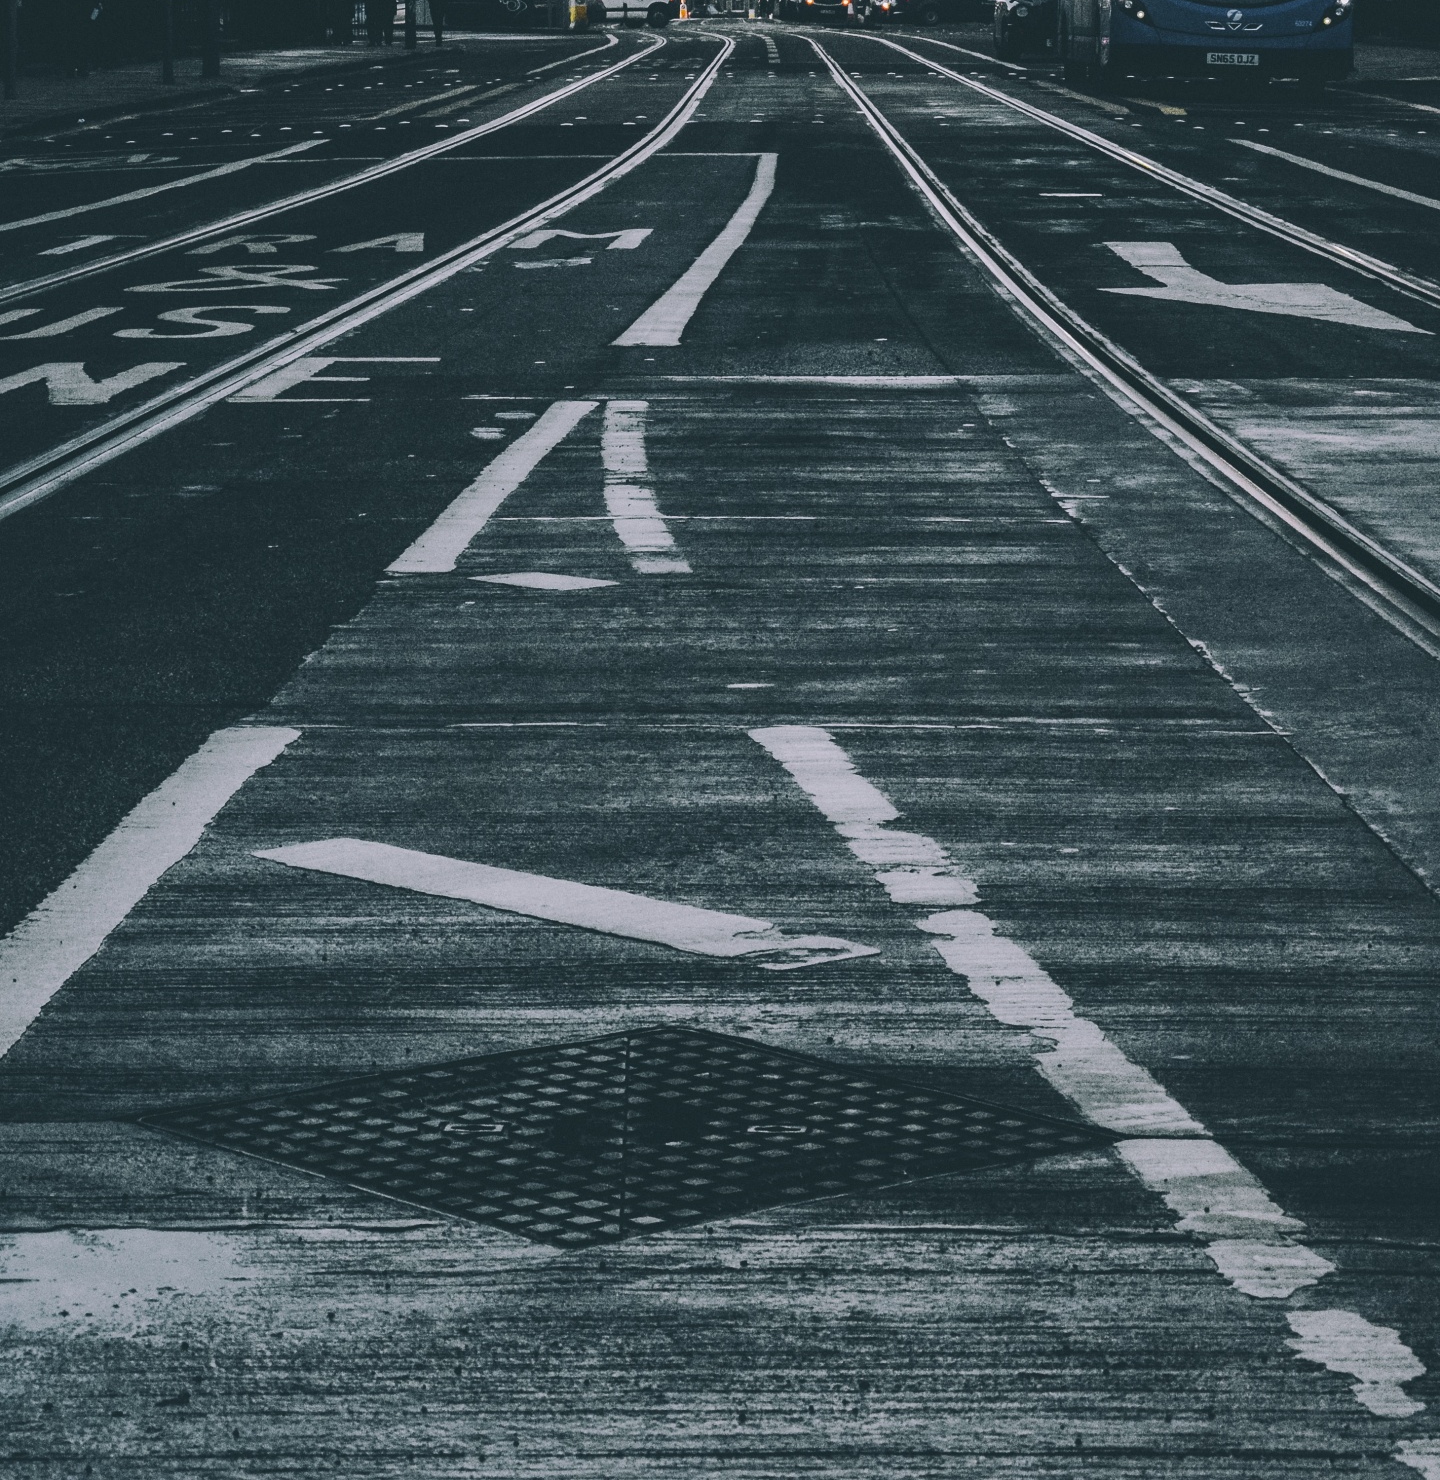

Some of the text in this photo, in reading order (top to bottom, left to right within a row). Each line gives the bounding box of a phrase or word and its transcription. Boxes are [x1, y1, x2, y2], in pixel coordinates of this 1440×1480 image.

[1210, 53, 1255, 64] SN65 OJZ
[0, 305, 292, 341] US
